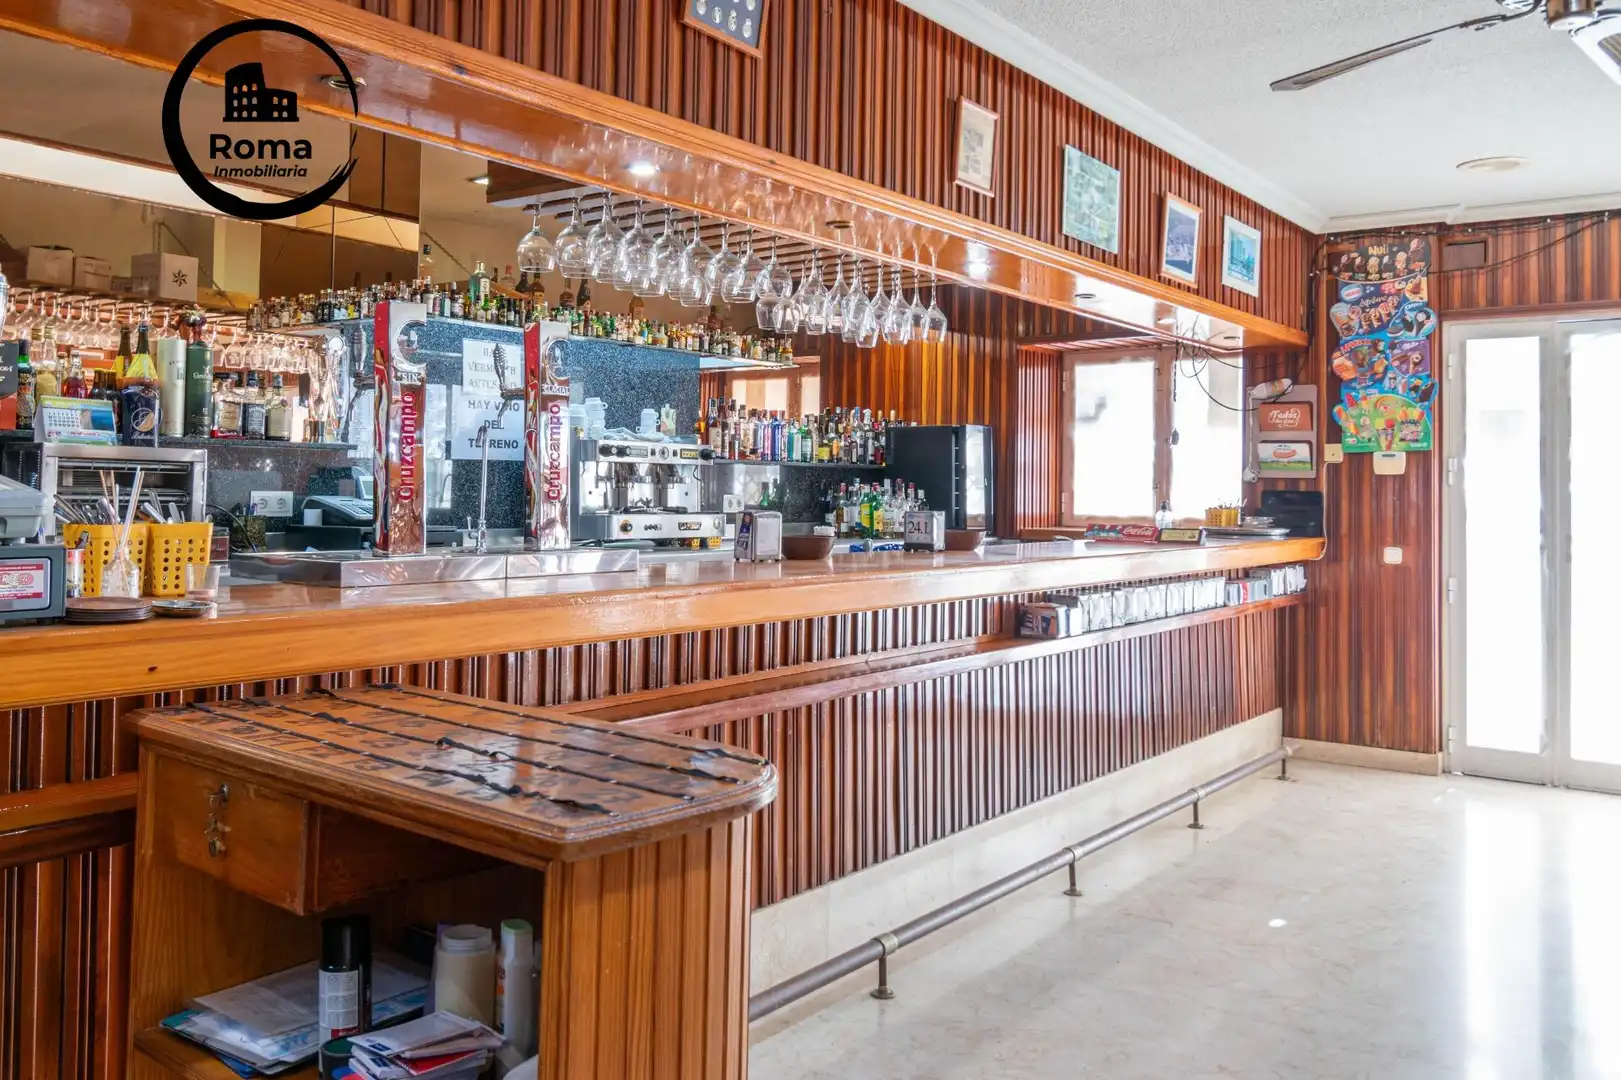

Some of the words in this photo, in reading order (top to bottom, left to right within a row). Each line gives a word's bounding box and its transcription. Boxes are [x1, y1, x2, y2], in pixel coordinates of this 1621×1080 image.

[468, 361, 517, 376] VERMH
[468, 378, 517, 389] ARTESO
[468, 400, 490, 409] HAY
[494, 402, 520, 411] VNO
[484, 420, 504, 429] DEL
[399, 392, 419, 501] Cruzcampo
[468, 438, 519, 449] TRENO
[547, 403, 564, 501] Cruzcampo
[1123, 526, 1154, 537] Coca-Cola
